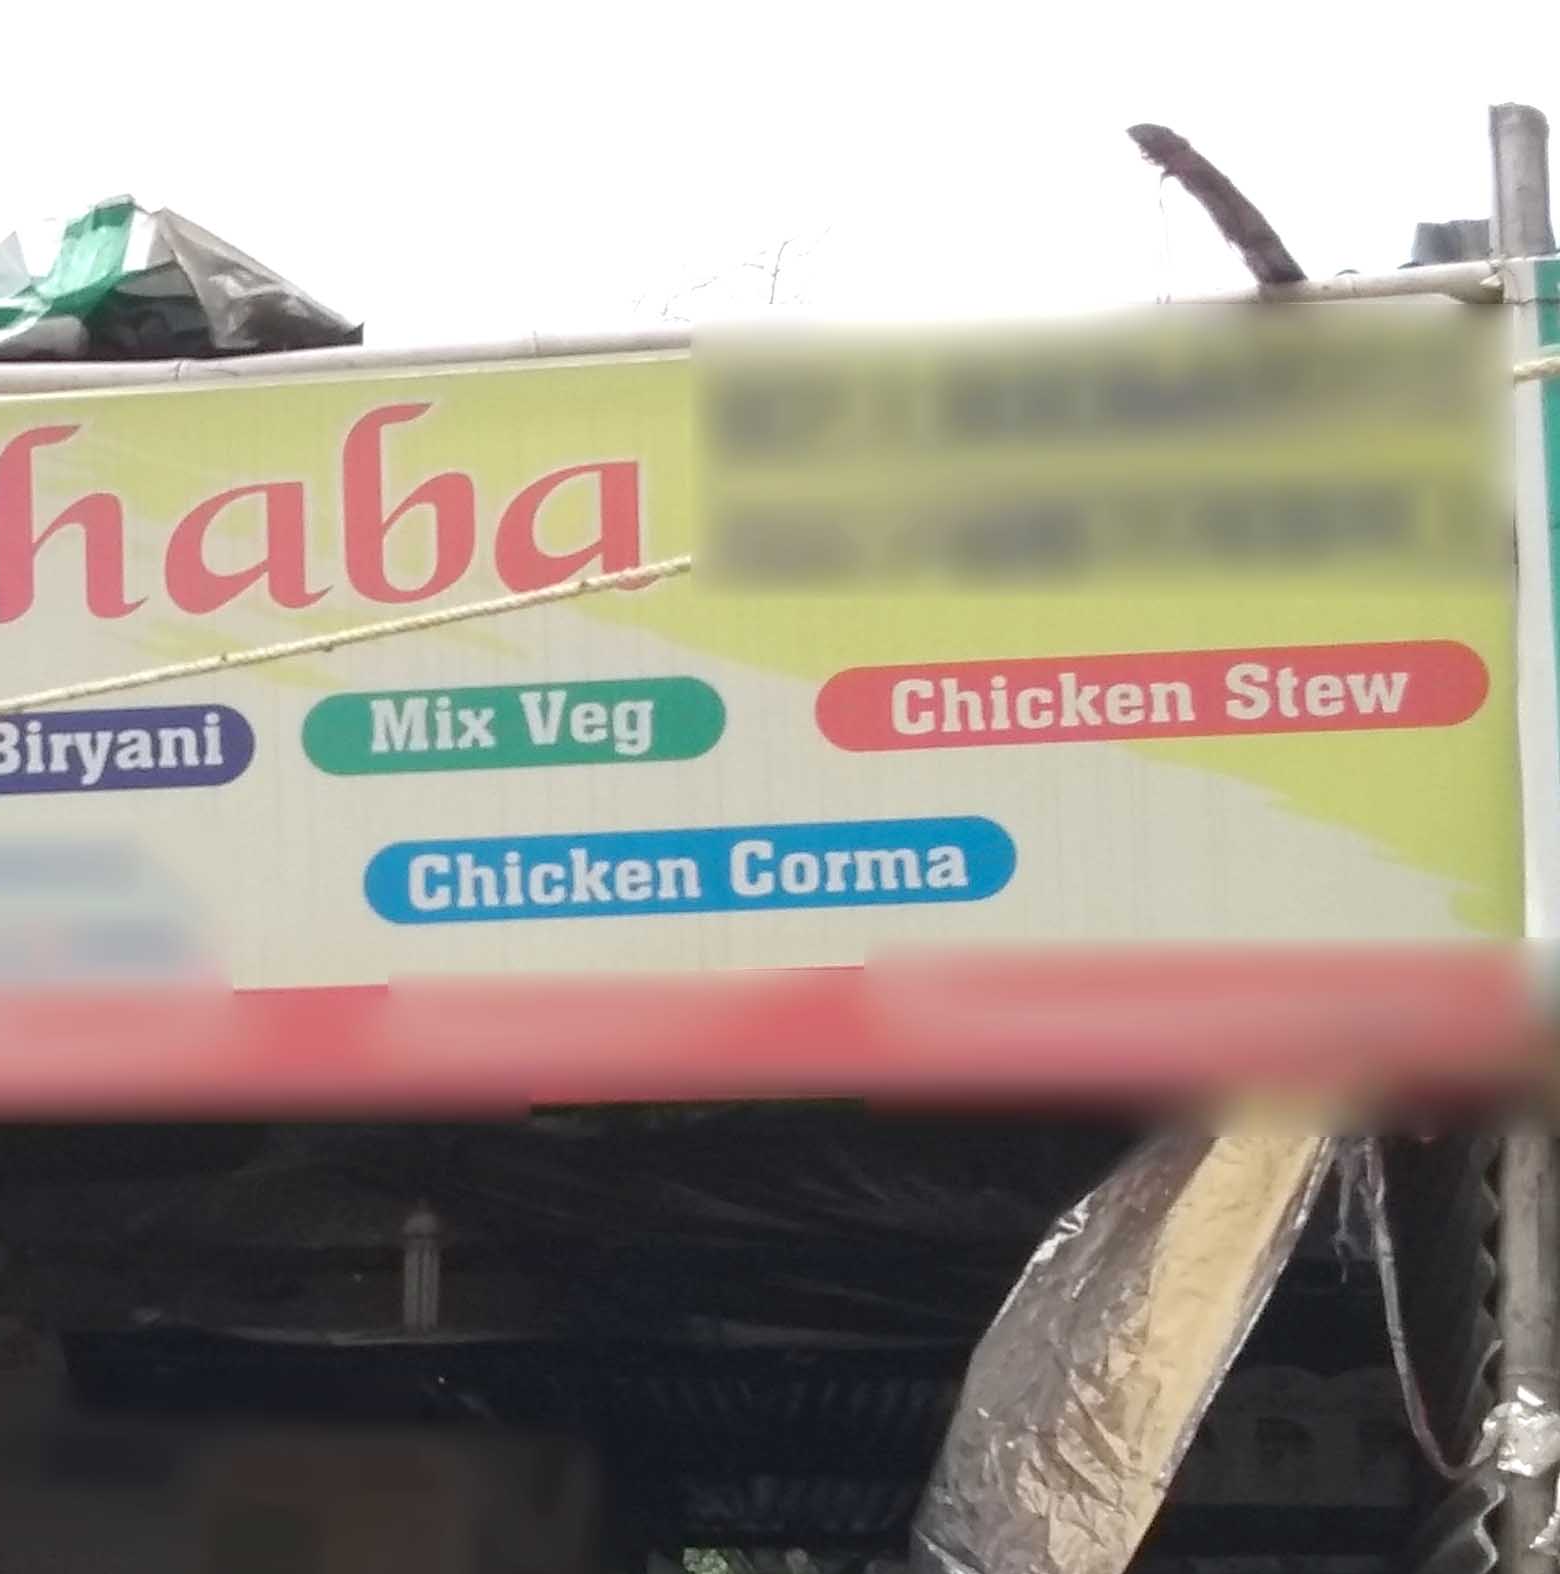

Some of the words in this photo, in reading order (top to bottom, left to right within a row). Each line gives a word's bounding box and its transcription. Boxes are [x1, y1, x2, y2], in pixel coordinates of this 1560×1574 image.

[370, 695, 495, 753] Mix
[519, 689, 655, 756] Veg
[891, 671, 1197, 736] Chicken
[1225, 662, 1410, 721] Stew
[408, 848, 701, 911] Chicken
[731, 840, 969, 896] Corma
